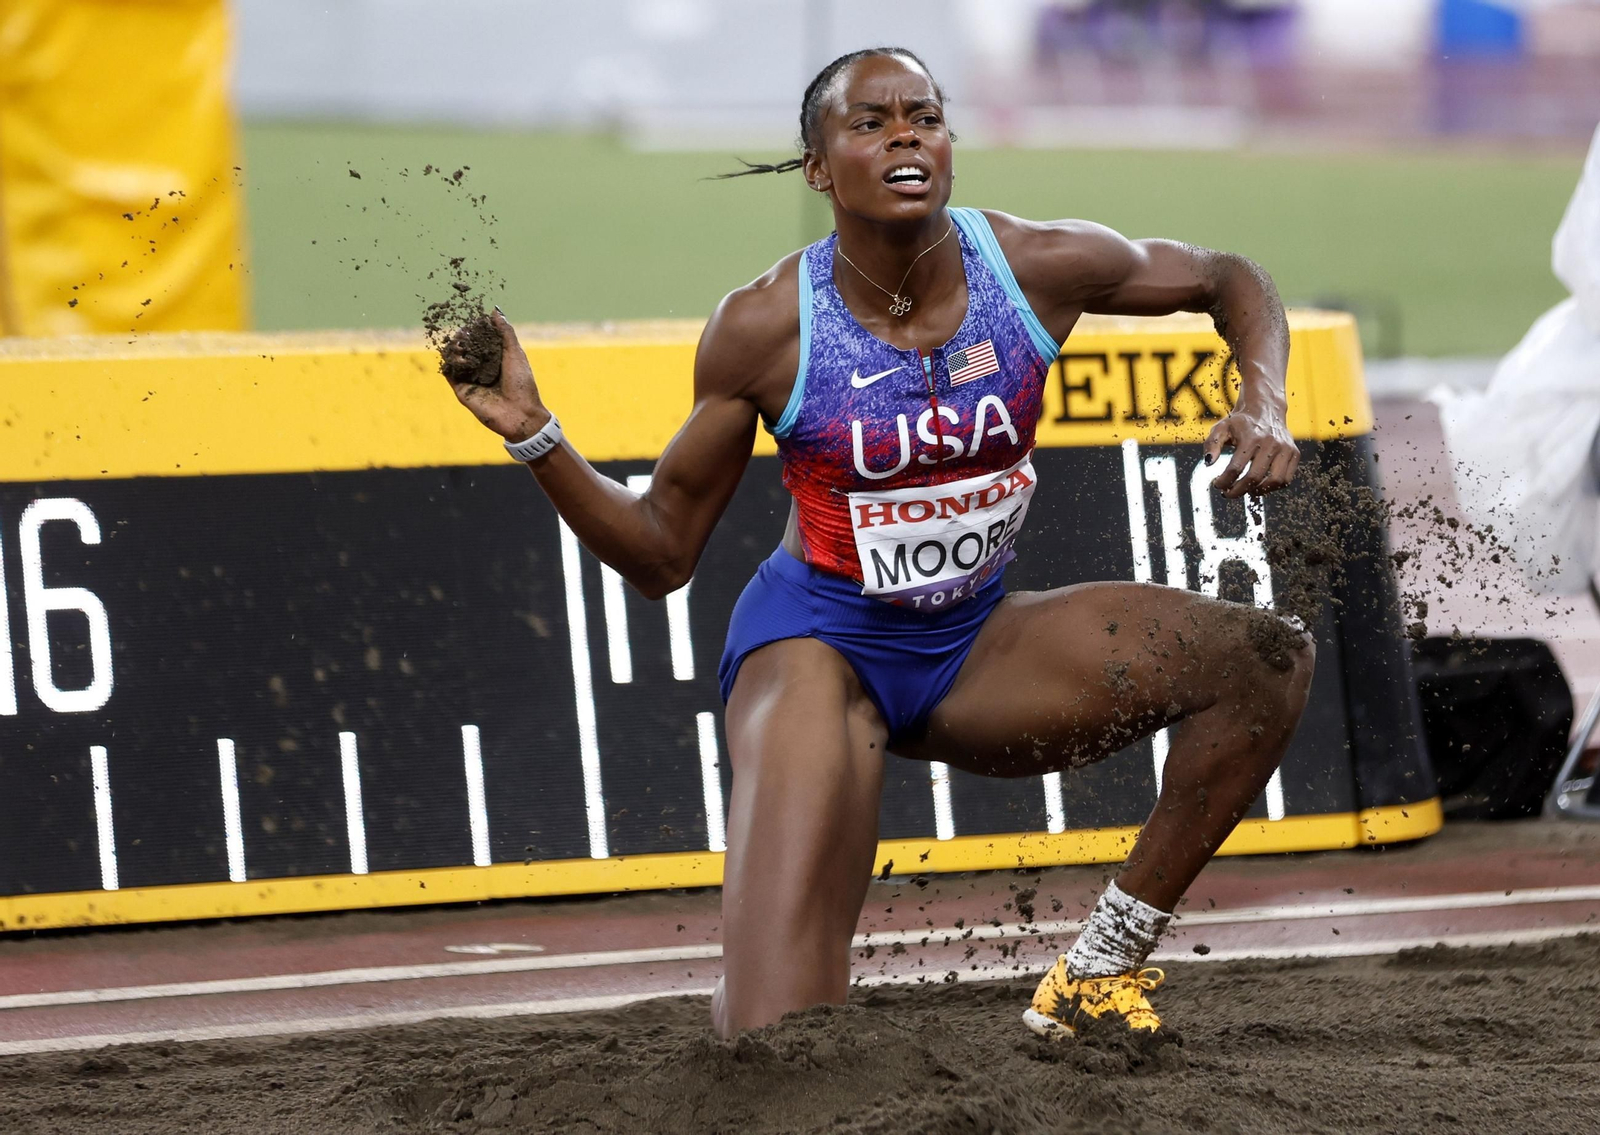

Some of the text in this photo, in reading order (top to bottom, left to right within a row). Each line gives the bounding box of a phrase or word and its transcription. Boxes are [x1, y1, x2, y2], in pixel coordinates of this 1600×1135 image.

[1039, 350, 1241, 424] EIK
[851, 395, 1019, 480] USA
[855, 469, 1033, 529] HONDA
[870, 503, 1022, 589] MOORE
[912, 564, 991, 609] TOKYO
